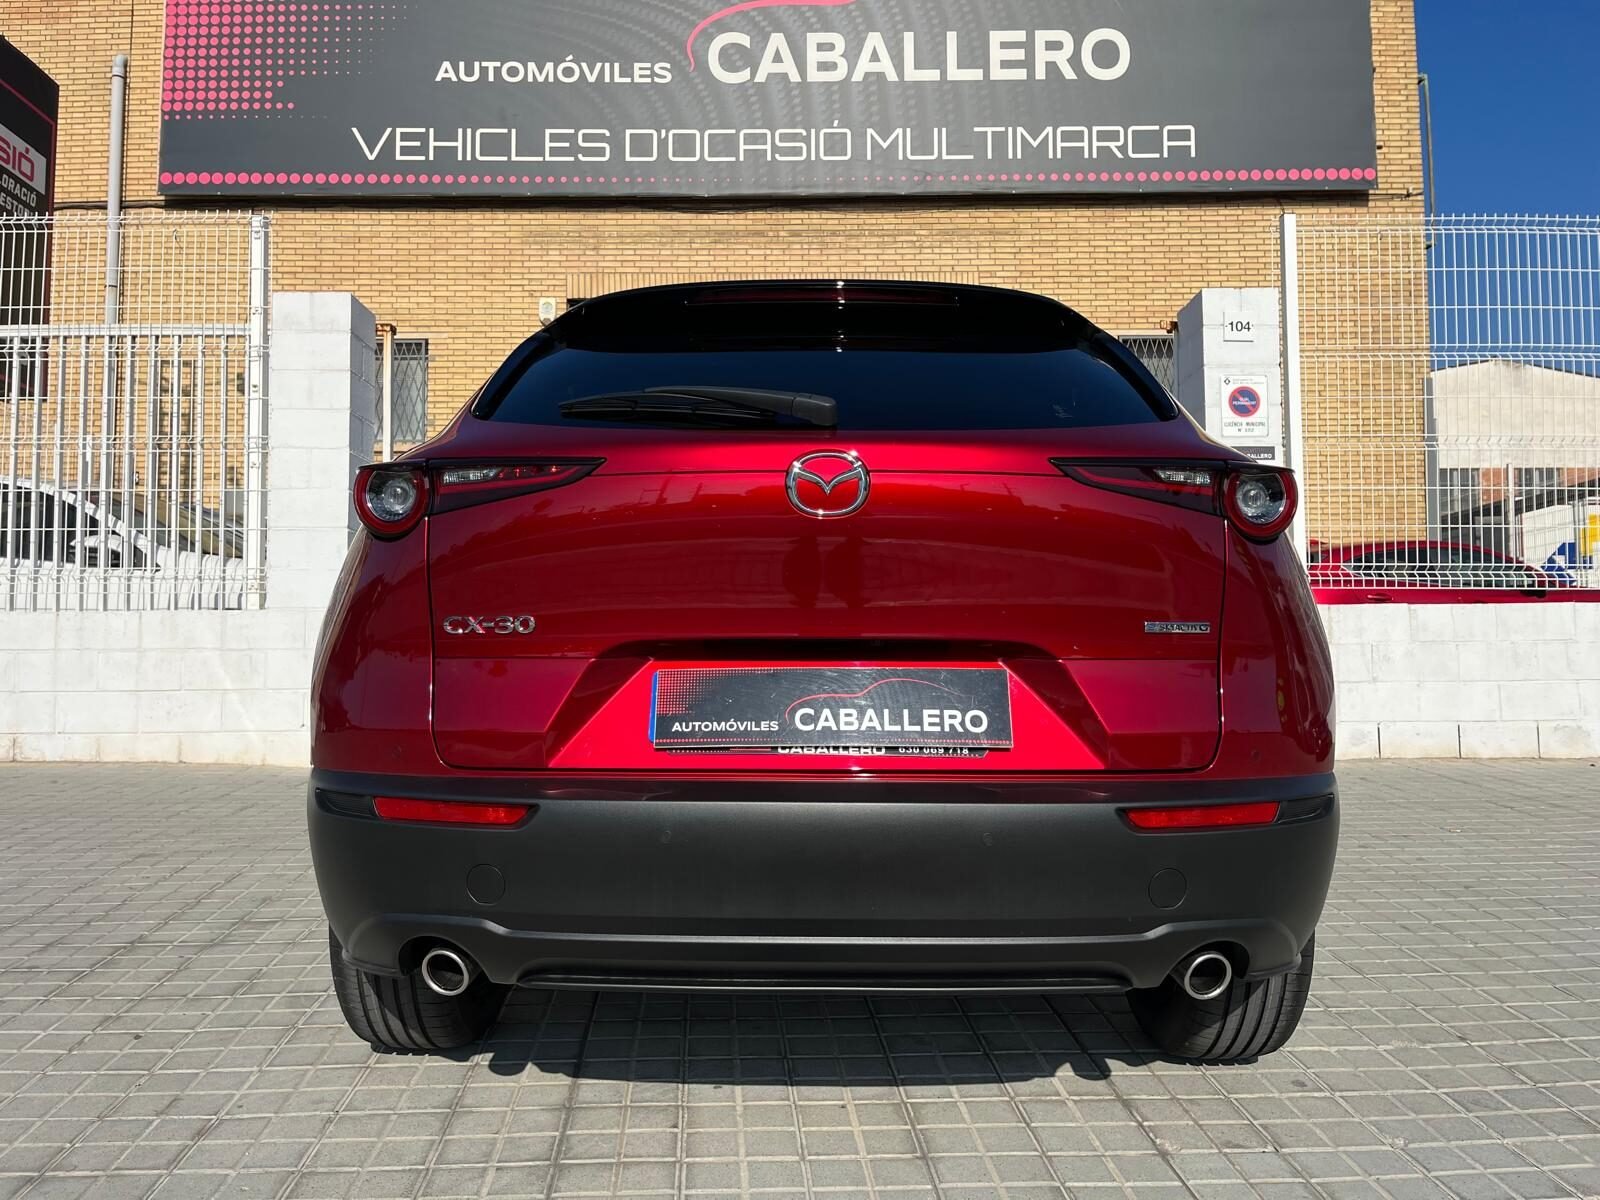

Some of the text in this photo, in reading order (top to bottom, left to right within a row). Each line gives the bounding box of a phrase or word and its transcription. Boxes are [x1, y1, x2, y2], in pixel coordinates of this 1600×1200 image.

[435, 28, 1131, 84] AUTOMÓVILES CABALLERO
[351, 120, 1196, 162] VEHICLES D'OCASIÓ MULTIMARCA
[0, 173, 37, 207] ORACIÓ
[1228, 320, 1251, 332] 104
[443, 615, 536, 634] CX-30
[672, 707, 989, 734] AUTOMÓVILES CABALLERO
